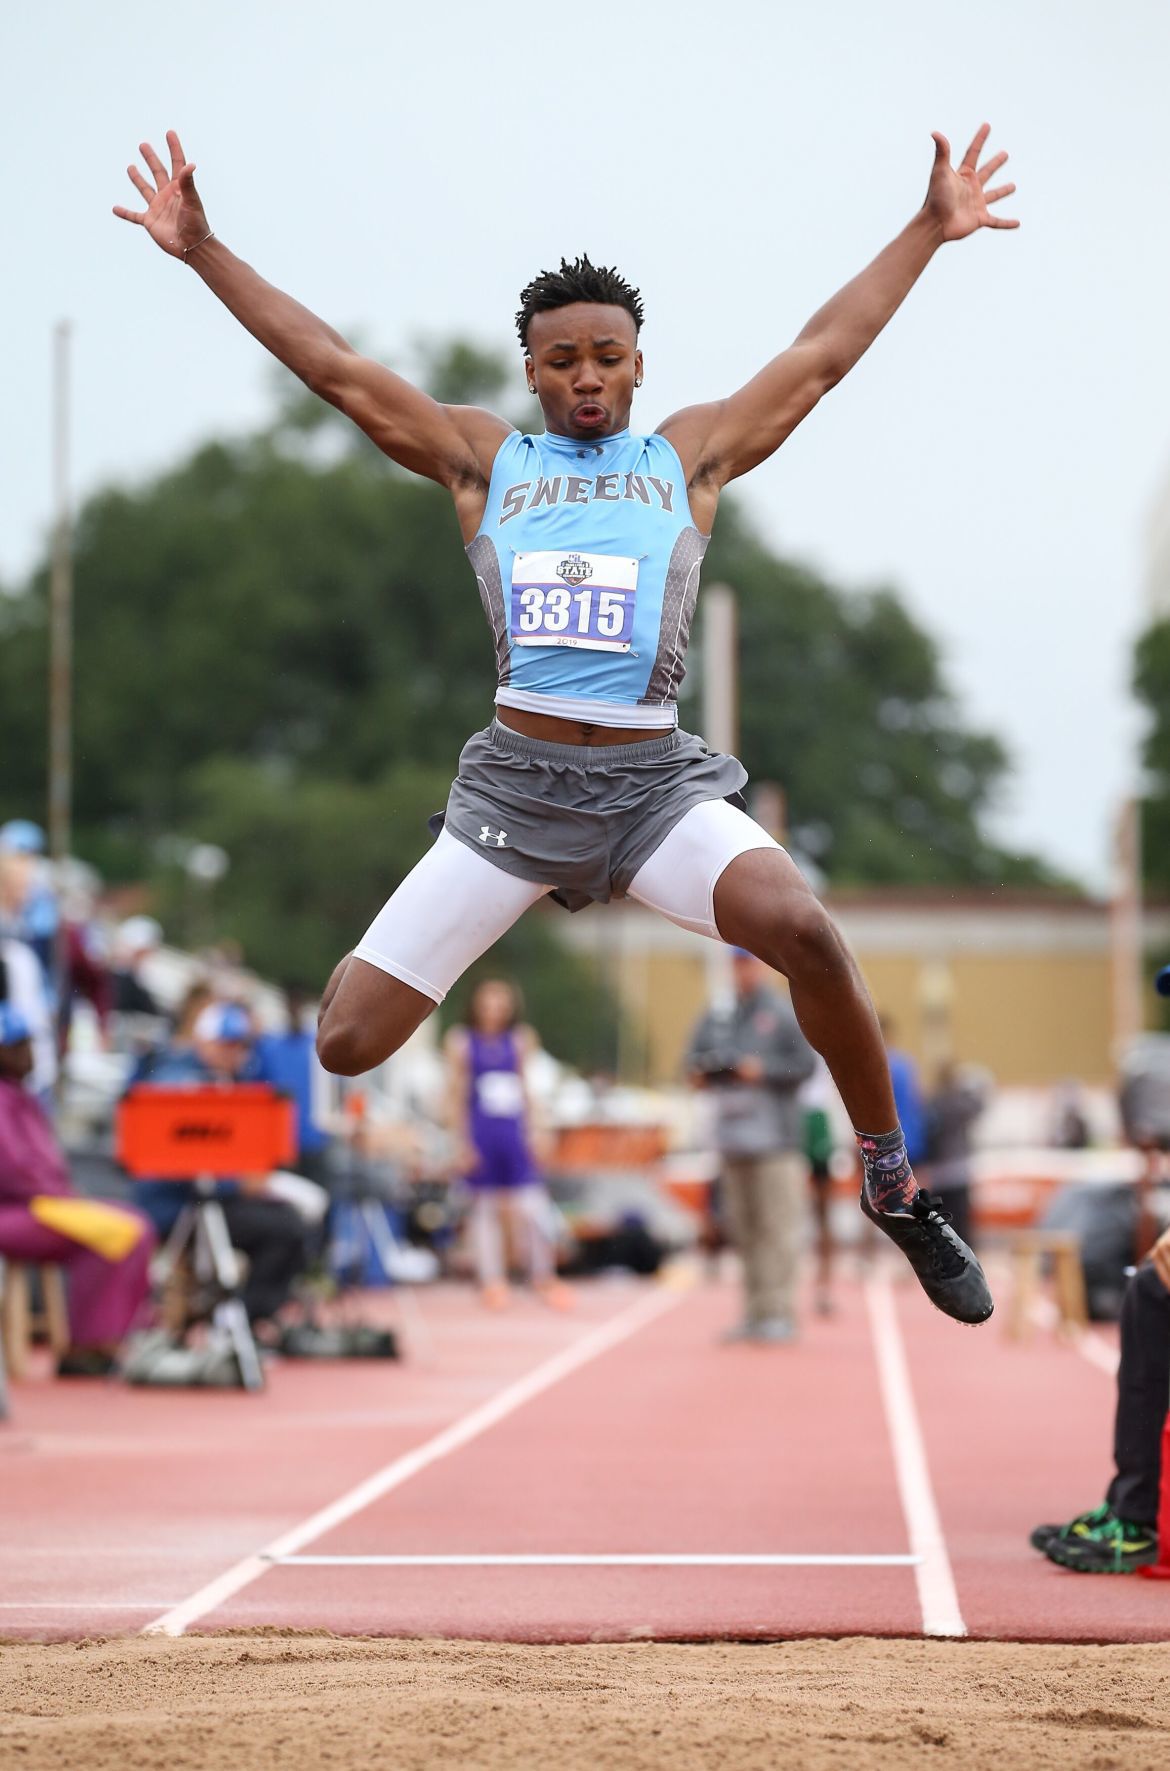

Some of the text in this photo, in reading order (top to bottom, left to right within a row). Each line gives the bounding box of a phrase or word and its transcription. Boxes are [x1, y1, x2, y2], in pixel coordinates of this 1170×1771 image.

[499, 471, 675, 526] SWEENY
[556, 566, 593, 576] STATE
[519, 587, 626, 637] 3315
[556, 637, 578, 646] 2019
